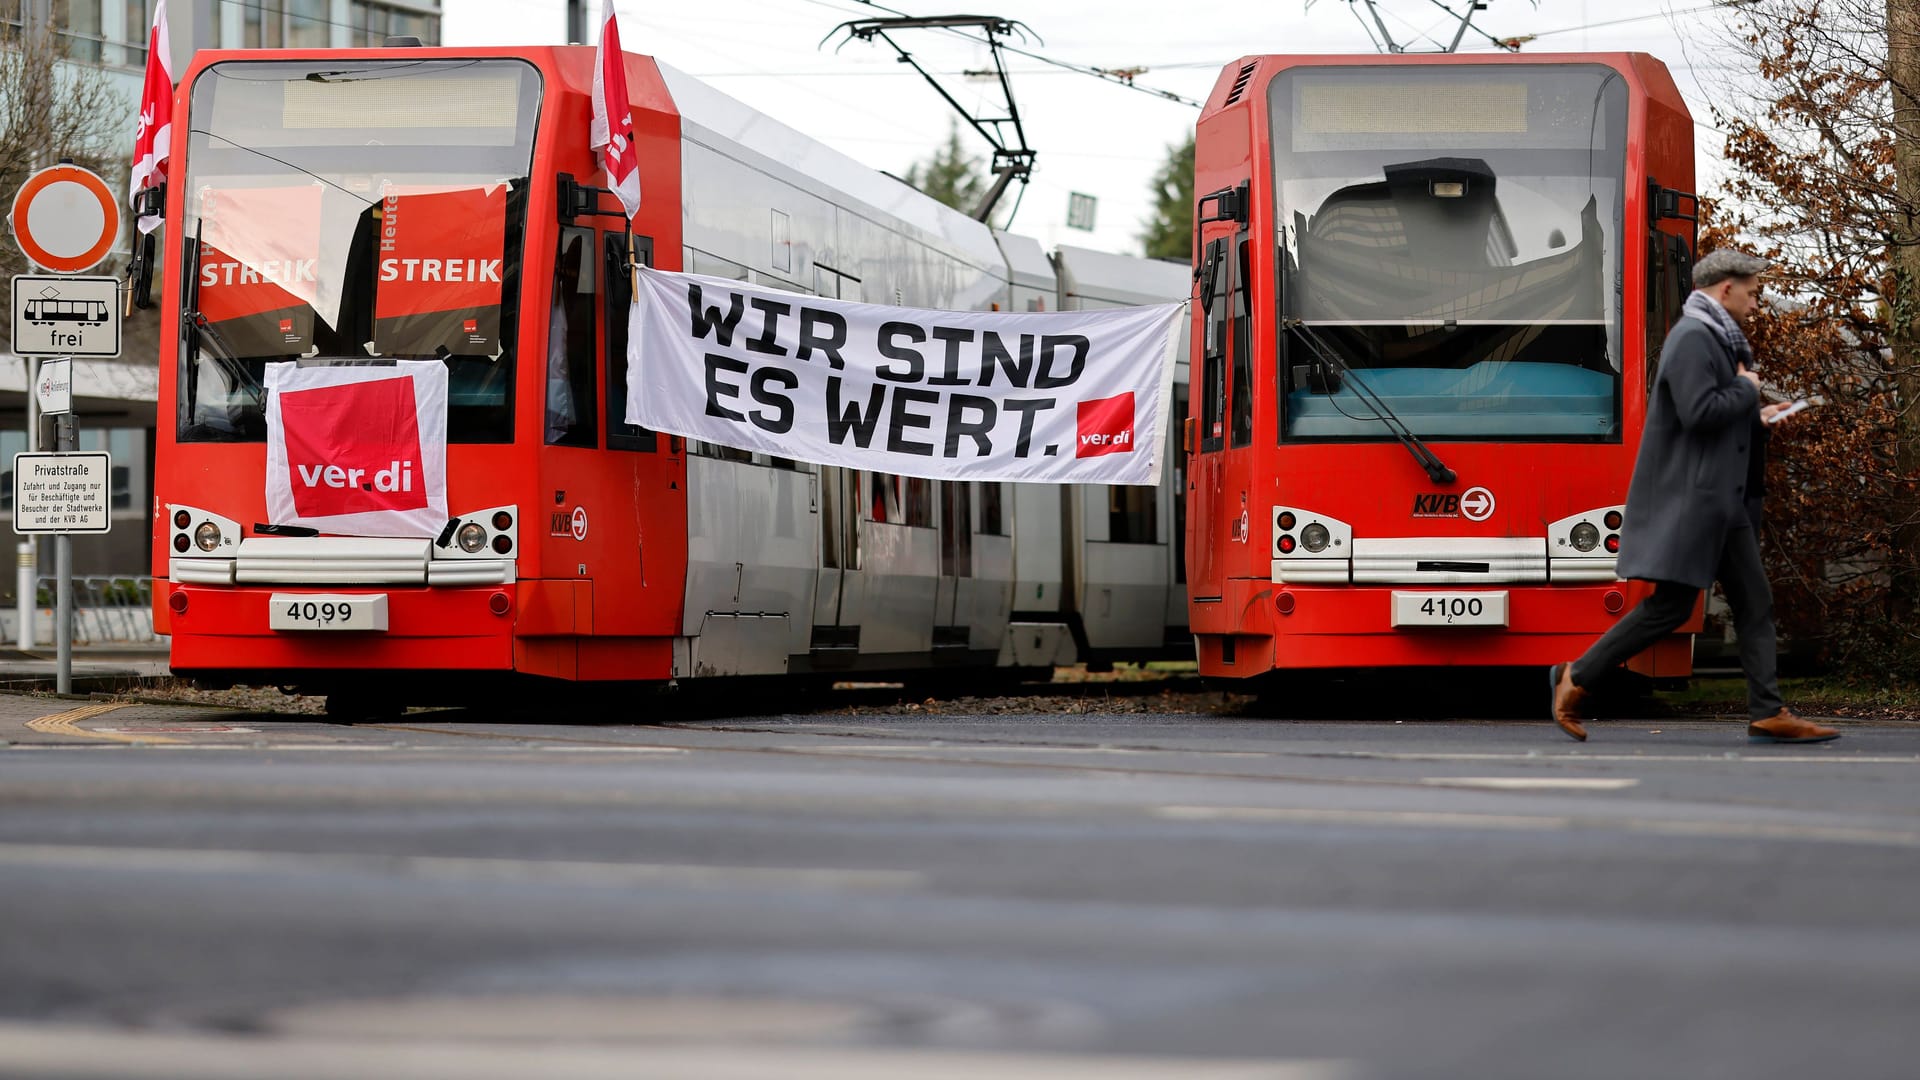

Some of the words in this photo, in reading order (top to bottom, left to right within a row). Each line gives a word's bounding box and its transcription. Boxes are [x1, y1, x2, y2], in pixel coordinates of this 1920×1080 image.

[201, 258, 317, 287] STREIK
[380, 258, 502, 283] STREIK
[50, 329, 83, 347] frei
[687, 283, 848, 371] WIR
[875, 321, 1090, 390] SIND
[704, 352, 799, 435] ES
[826, 375, 1059, 459] WERT.
[1080, 429, 1131, 446] ver.di
[34, 464, 89, 476] Privatstraße
[297, 460, 412, 493] ver.di
[23, 481, 46, 491] Zufahrt
[48, 482, 61, 491] und
[63, 481, 87, 493] Zugang
[89, 482, 102, 491] nur
[28, 493, 38, 502] für
[40, 493, 80, 504] Beschäftigte
[83, 493, 96, 501] und
[1413, 494, 1460, 513] KVB
[21, 504, 49, 513] Besucher
[52, 504, 63, 513] der
[66, 504, 103, 512] Stadtwerke
[35, 516, 46, 524] und
[49, 515, 60, 524] der
[63, 515, 77, 523] KVB
[79, 515, 89, 523] AG
[551, 513, 572, 533] KVB
[287, 602, 352, 622] 4099
[1420, 597, 1483, 616] 4100
[1447, 613, 1453, 624] 2
